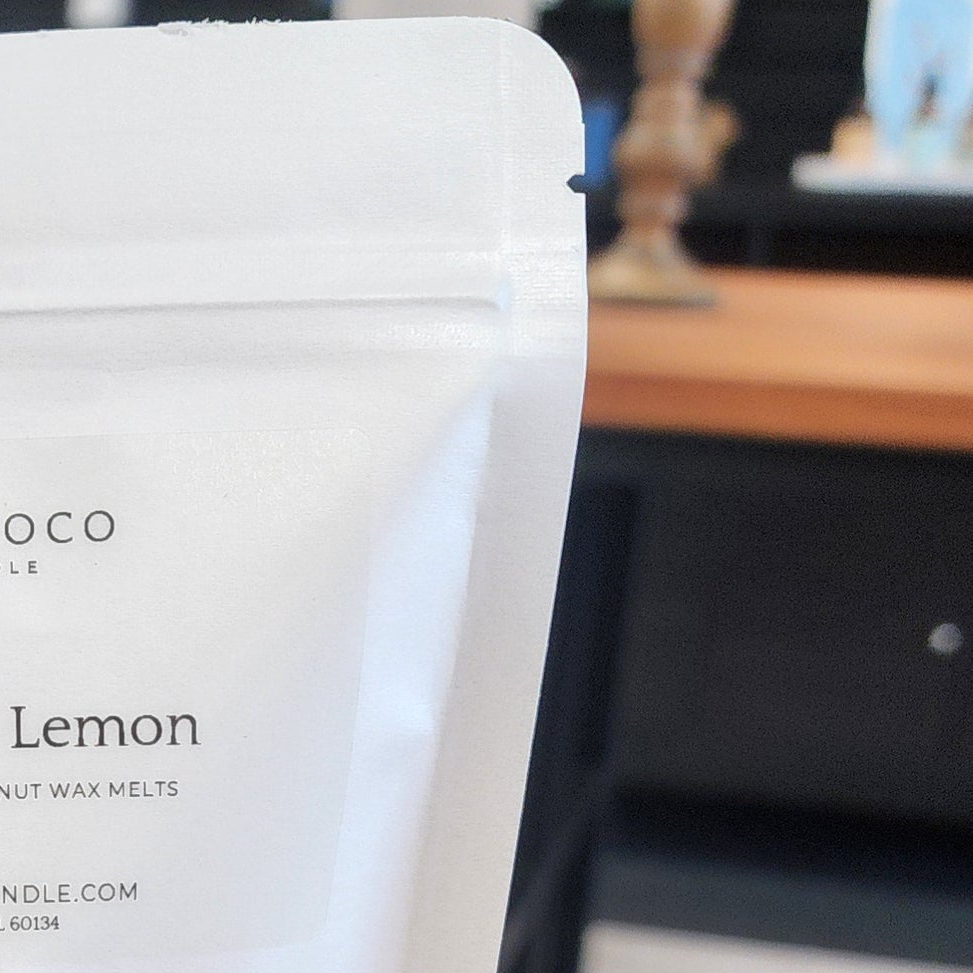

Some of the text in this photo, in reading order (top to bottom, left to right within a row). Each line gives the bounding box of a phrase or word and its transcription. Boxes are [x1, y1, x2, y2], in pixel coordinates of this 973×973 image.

[9, 705, 202, 749] Lemon
[48, 781, 101, 799] WAX
[108, 780, 179, 798] MELTS
[9, 915, 60, 932] 60134
